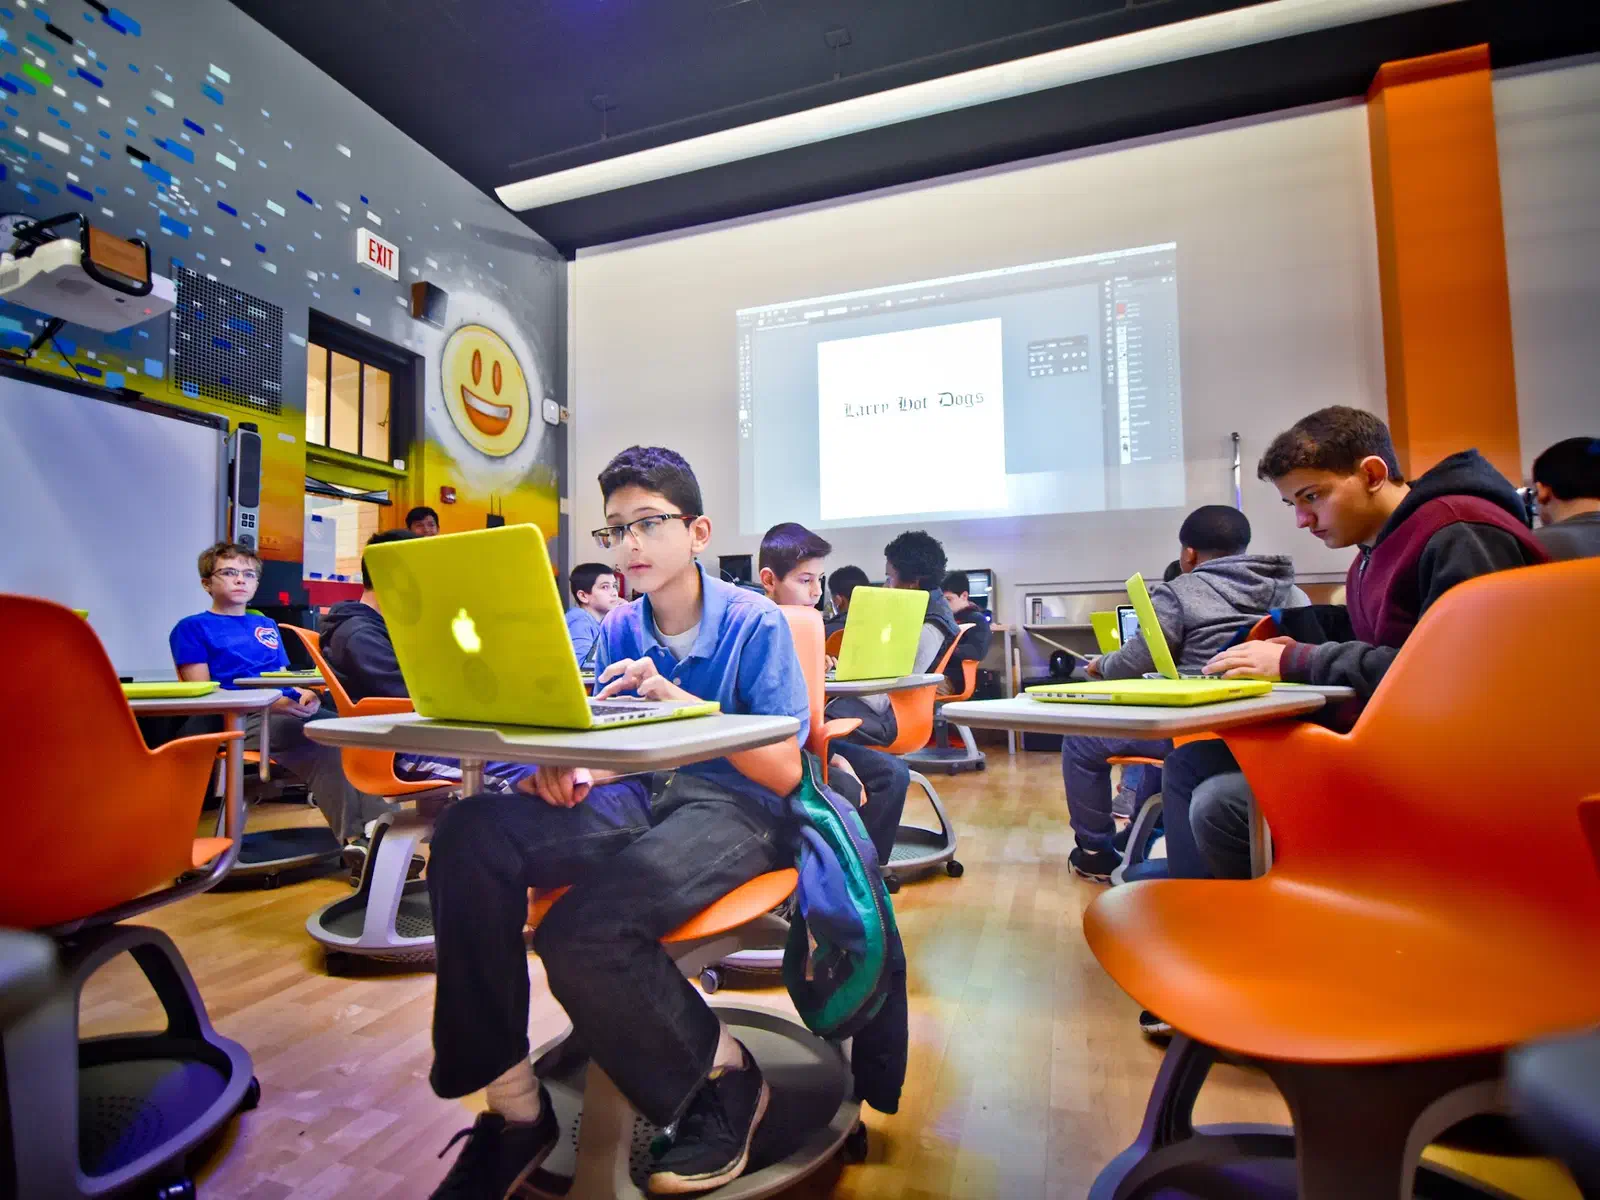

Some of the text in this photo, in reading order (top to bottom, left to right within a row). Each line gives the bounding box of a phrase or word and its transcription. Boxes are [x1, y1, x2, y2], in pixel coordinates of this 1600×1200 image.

[369, 238, 394, 271] EXIT
[844, 391, 984, 417] Larry Hot Dogs
